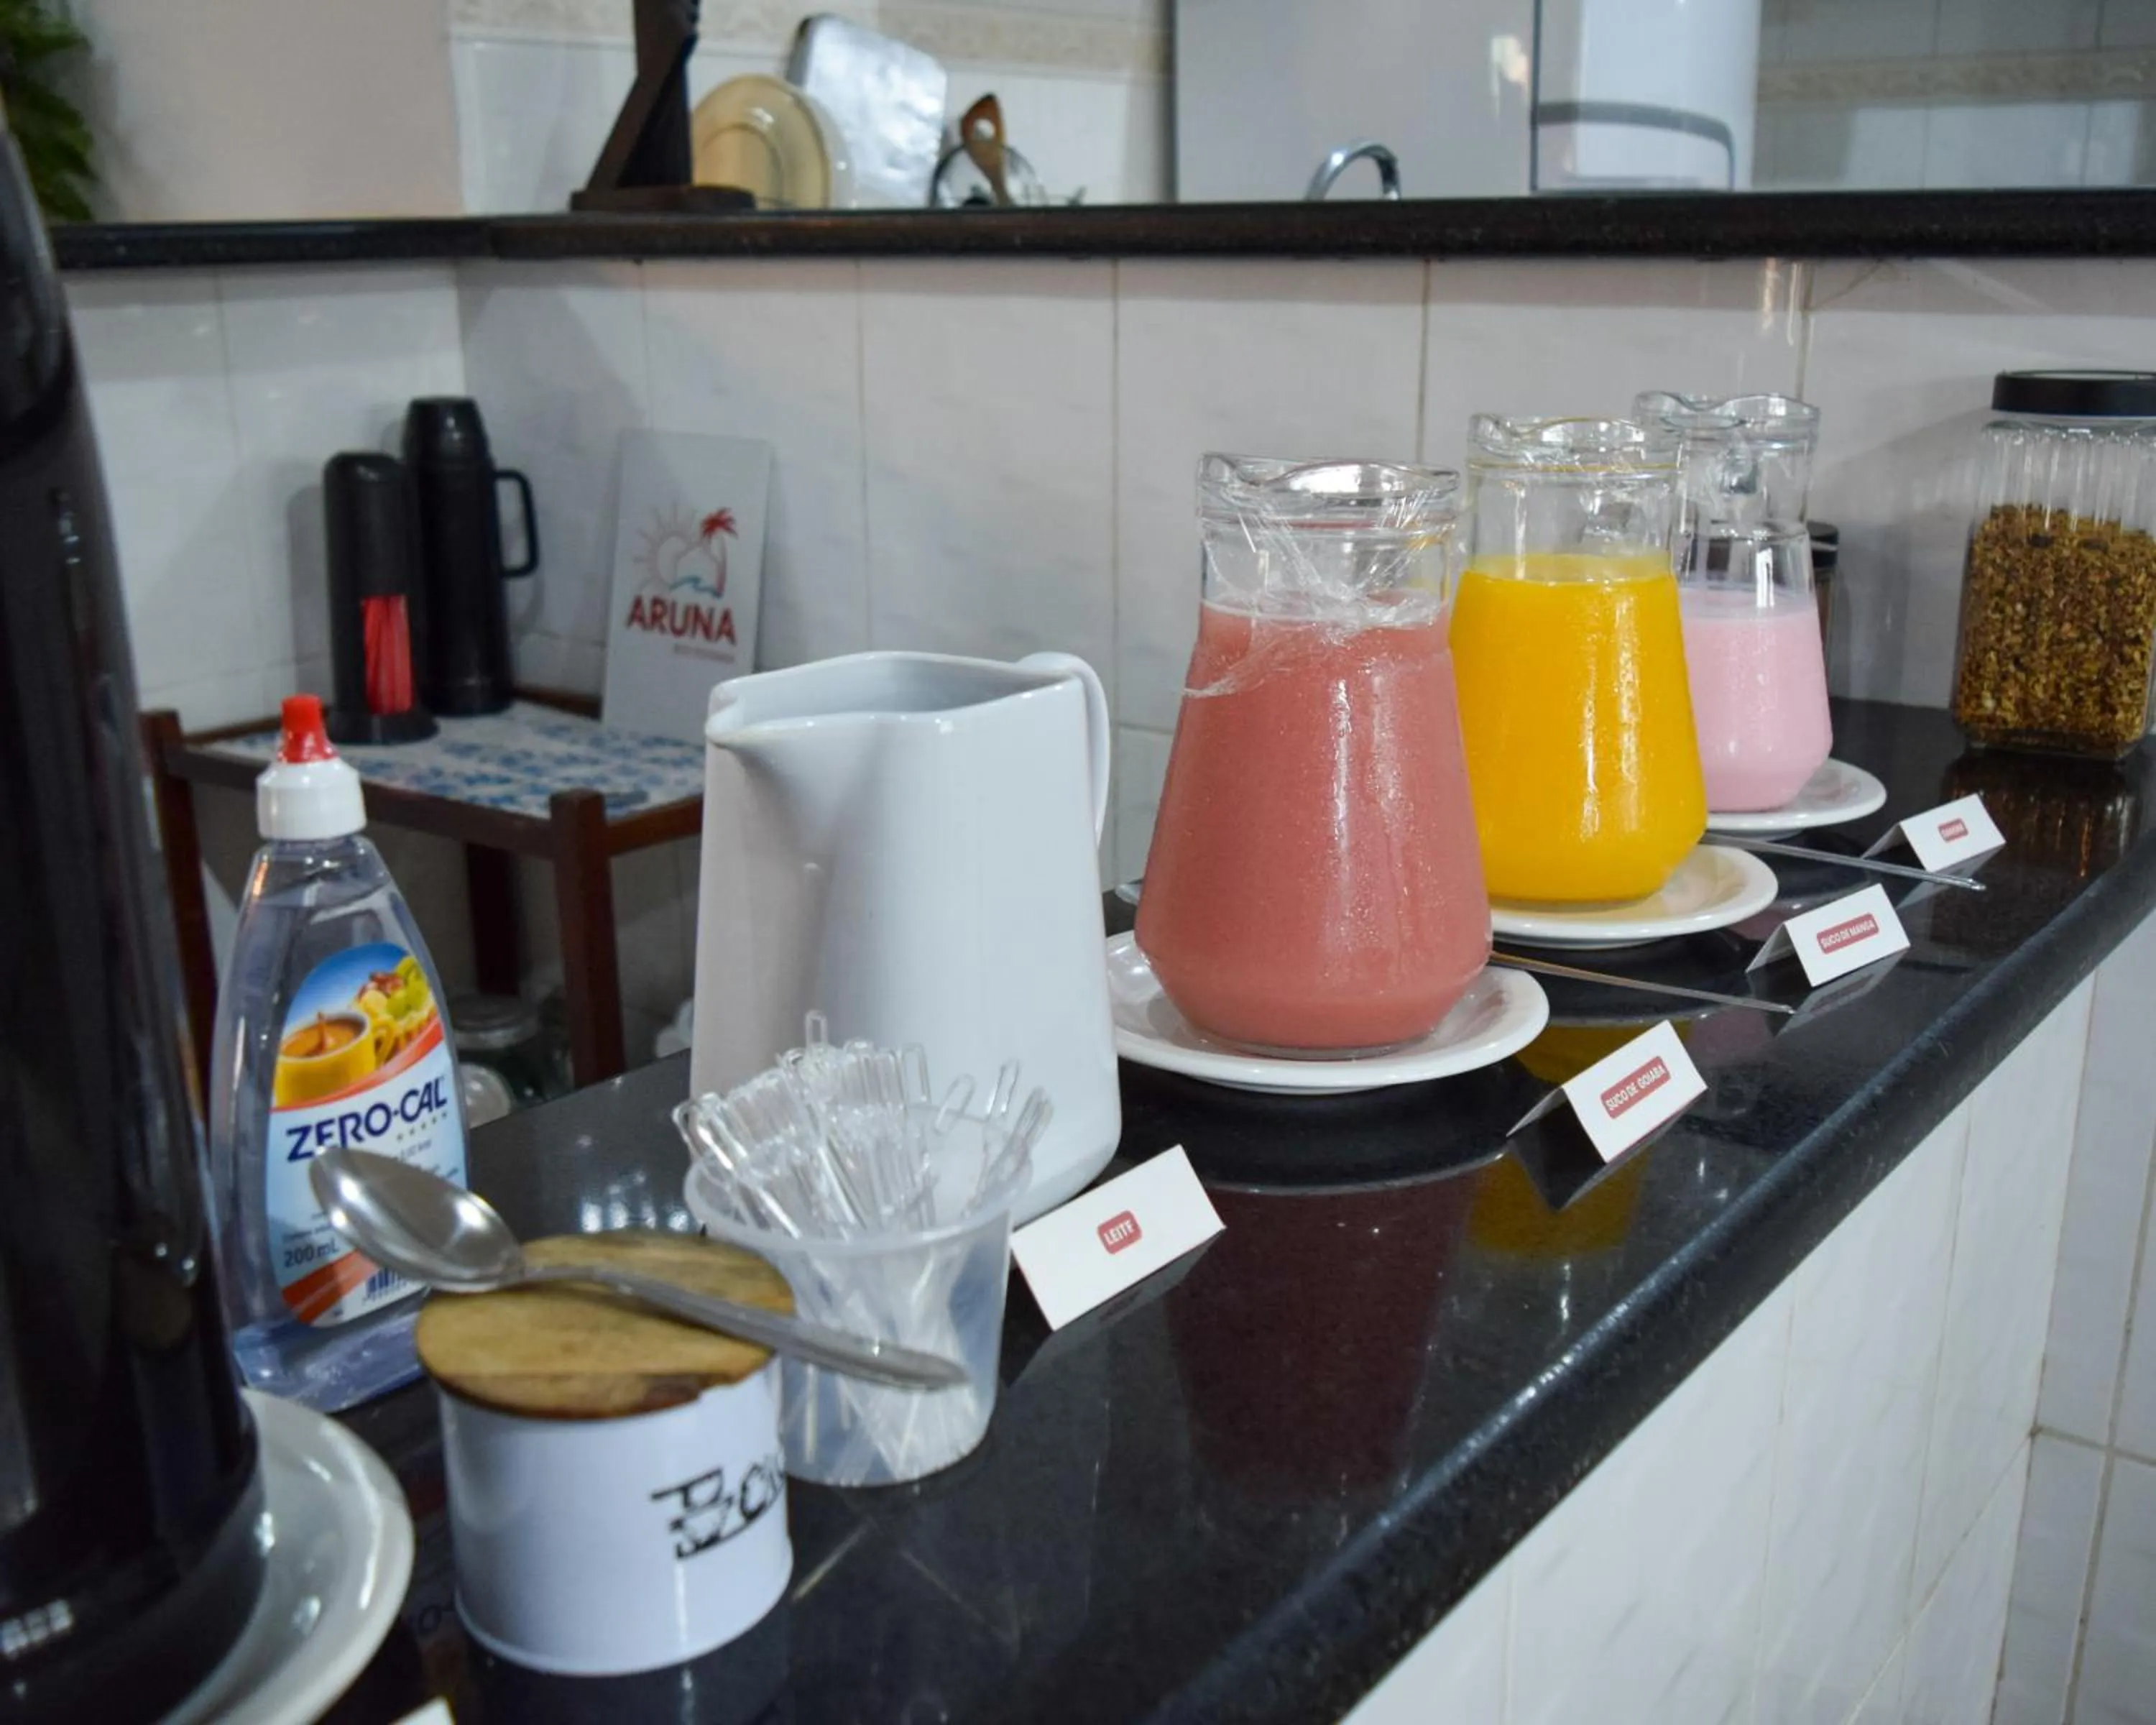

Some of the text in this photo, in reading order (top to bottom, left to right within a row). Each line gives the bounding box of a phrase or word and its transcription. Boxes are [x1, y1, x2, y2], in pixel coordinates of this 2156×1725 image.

[625, 594, 737, 646] ARUNA
[1820, 932, 1841, 949] SUCO
[1606, 1089, 1629, 1110] SUCO
[1626, 1082, 1639, 1098] DE
[1103, 1219, 1135, 1245] LEITE
[283, 1243, 315, 1269] 200
